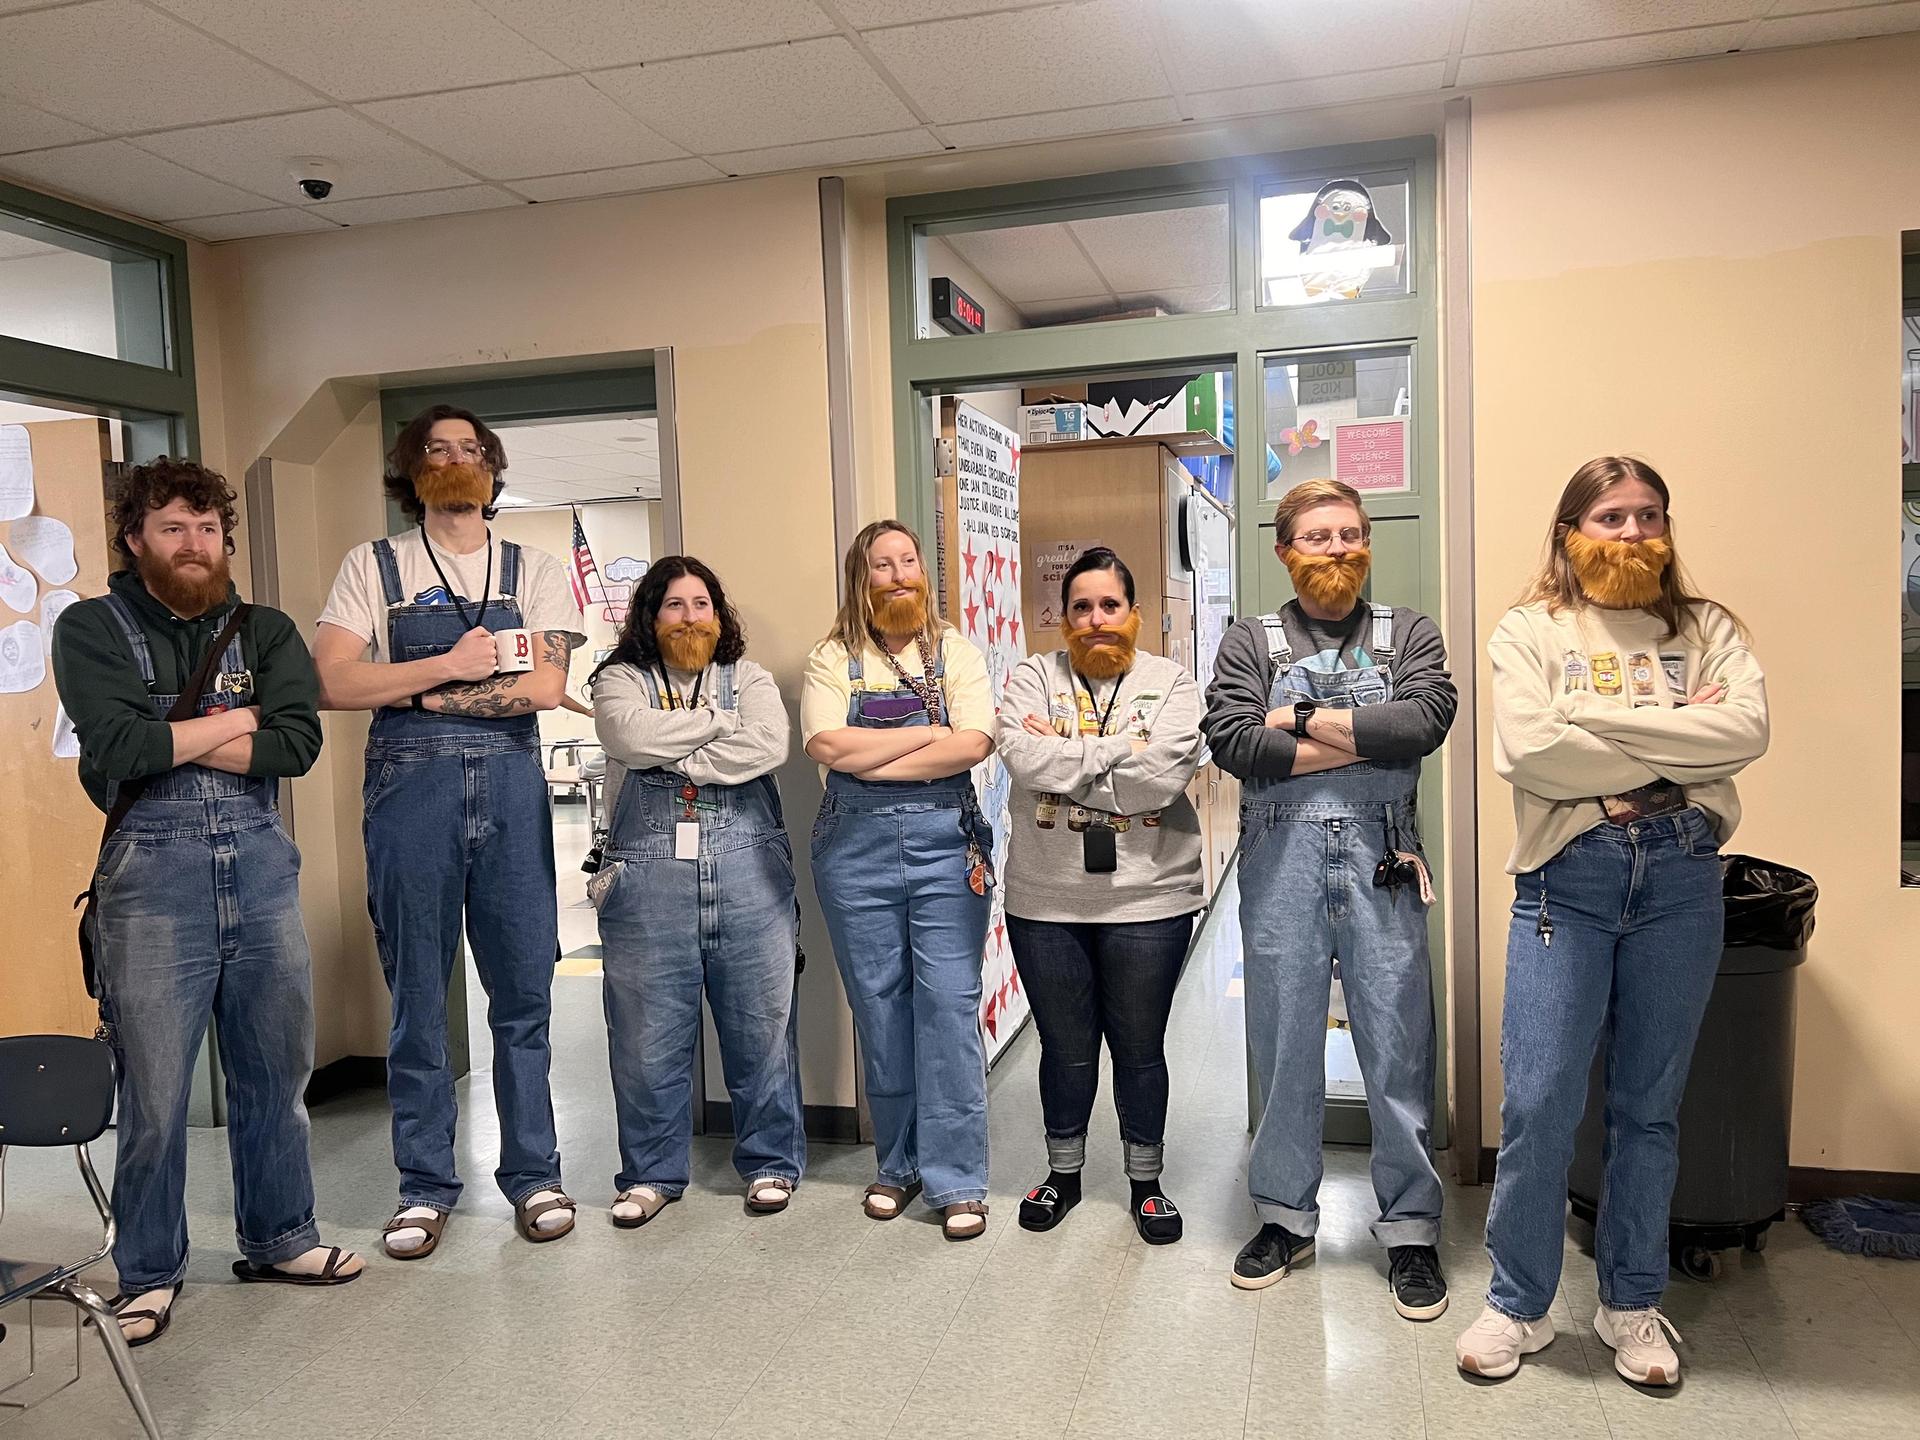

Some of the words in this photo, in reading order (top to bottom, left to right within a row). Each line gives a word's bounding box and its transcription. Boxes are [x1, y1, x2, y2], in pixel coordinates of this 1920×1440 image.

[1064, 411, 1075, 420] 1G
[958, 414, 968, 429] HER
[969, 418, 988, 437] ACTIONS
[1347, 428, 1391, 440] WELCOME
[971, 441, 983, 458] EVEN
[1365, 441, 1376, 449] TO
[1350, 451, 1391, 462] SCIENCE
[1357, 463, 1380, 473] WITH
[959, 478, 969, 491] ONE
[1037, 552, 1069, 568] great
[514, 633, 529, 657] B
